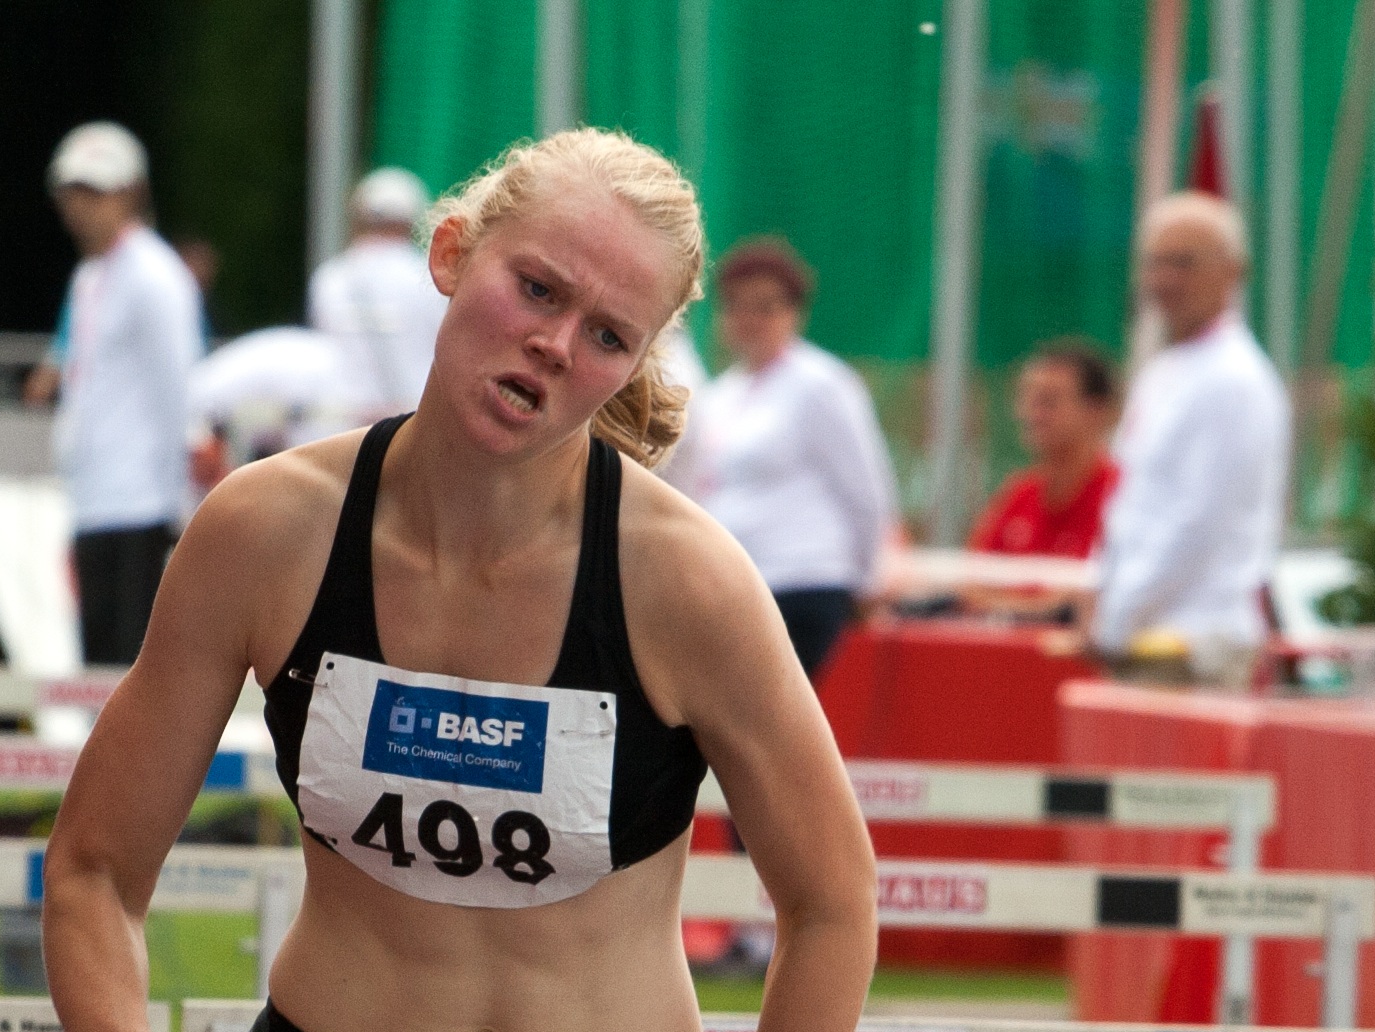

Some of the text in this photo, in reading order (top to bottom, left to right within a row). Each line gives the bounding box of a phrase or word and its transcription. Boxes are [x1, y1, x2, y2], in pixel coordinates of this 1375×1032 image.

[436, 711, 525, 748] BASF
[386, 741, 522, 772] The Chemical Company
[351, 792, 556, 886] 498
